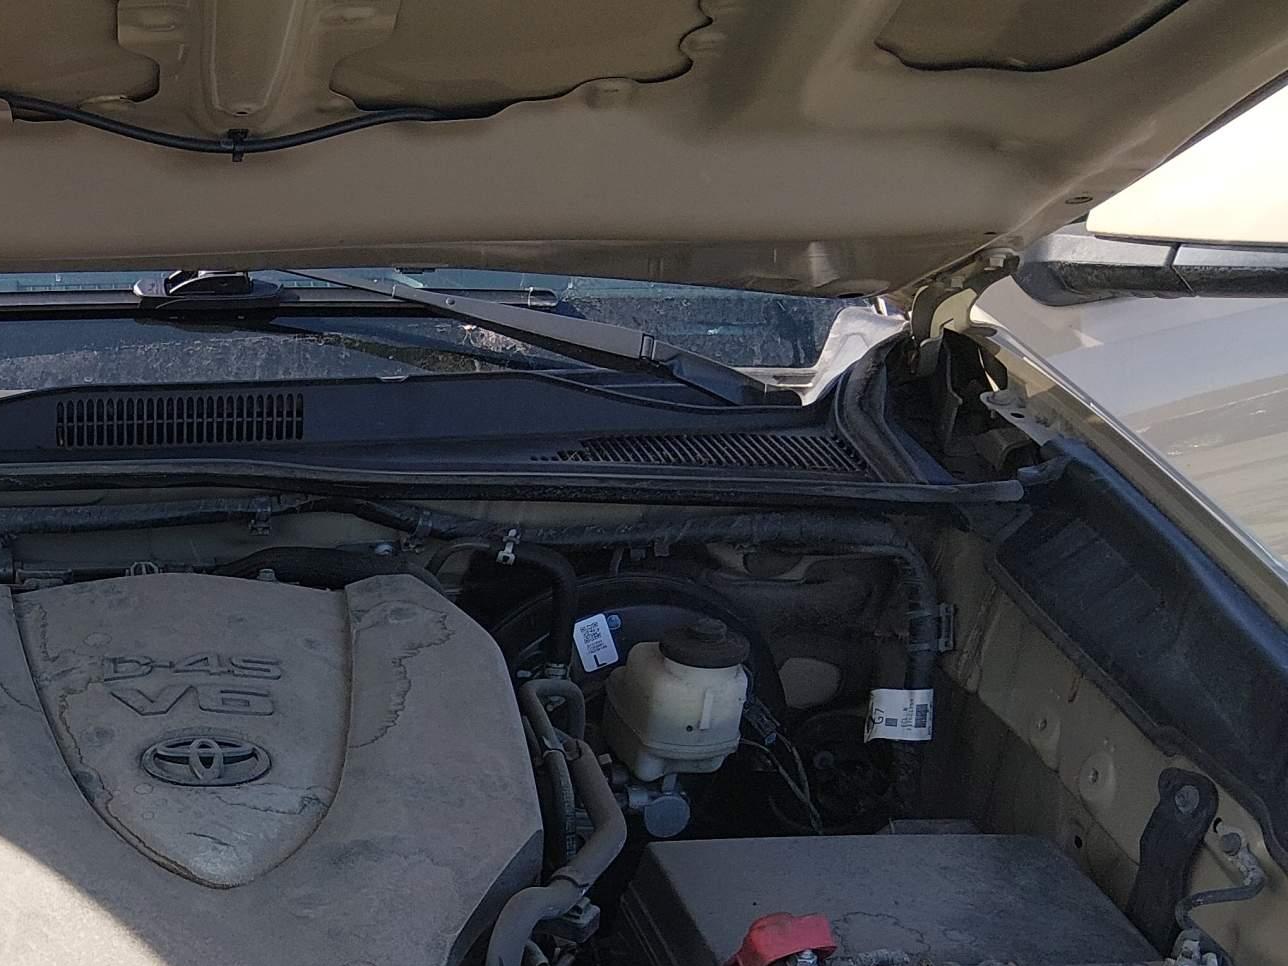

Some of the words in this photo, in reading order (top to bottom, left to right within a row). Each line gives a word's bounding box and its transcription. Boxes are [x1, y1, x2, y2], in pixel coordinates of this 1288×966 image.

[103, 655, 282, 681] D-4S
[593, 654, 608, 667] L
[110, 684, 275, 717] V6
